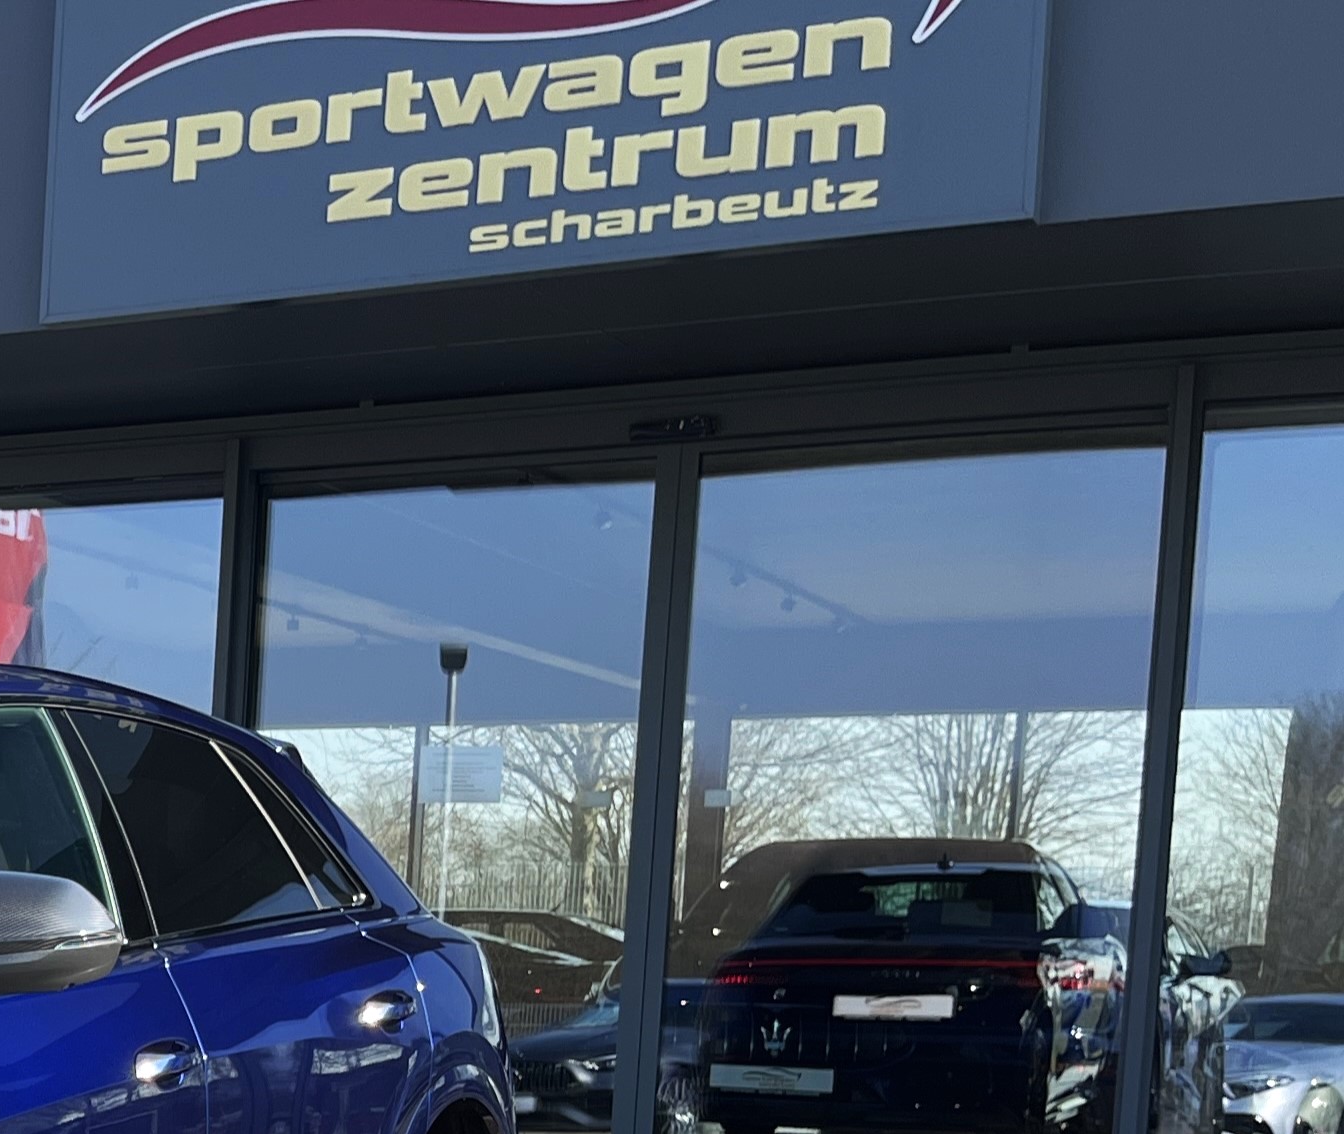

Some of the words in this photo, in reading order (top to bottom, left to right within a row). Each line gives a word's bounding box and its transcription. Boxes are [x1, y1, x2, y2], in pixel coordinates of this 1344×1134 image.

[101, 16, 892, 182] sportwagen
[326, 103, 887, 224] zentrum
[468, 178, 880, 254] scharbeutz
